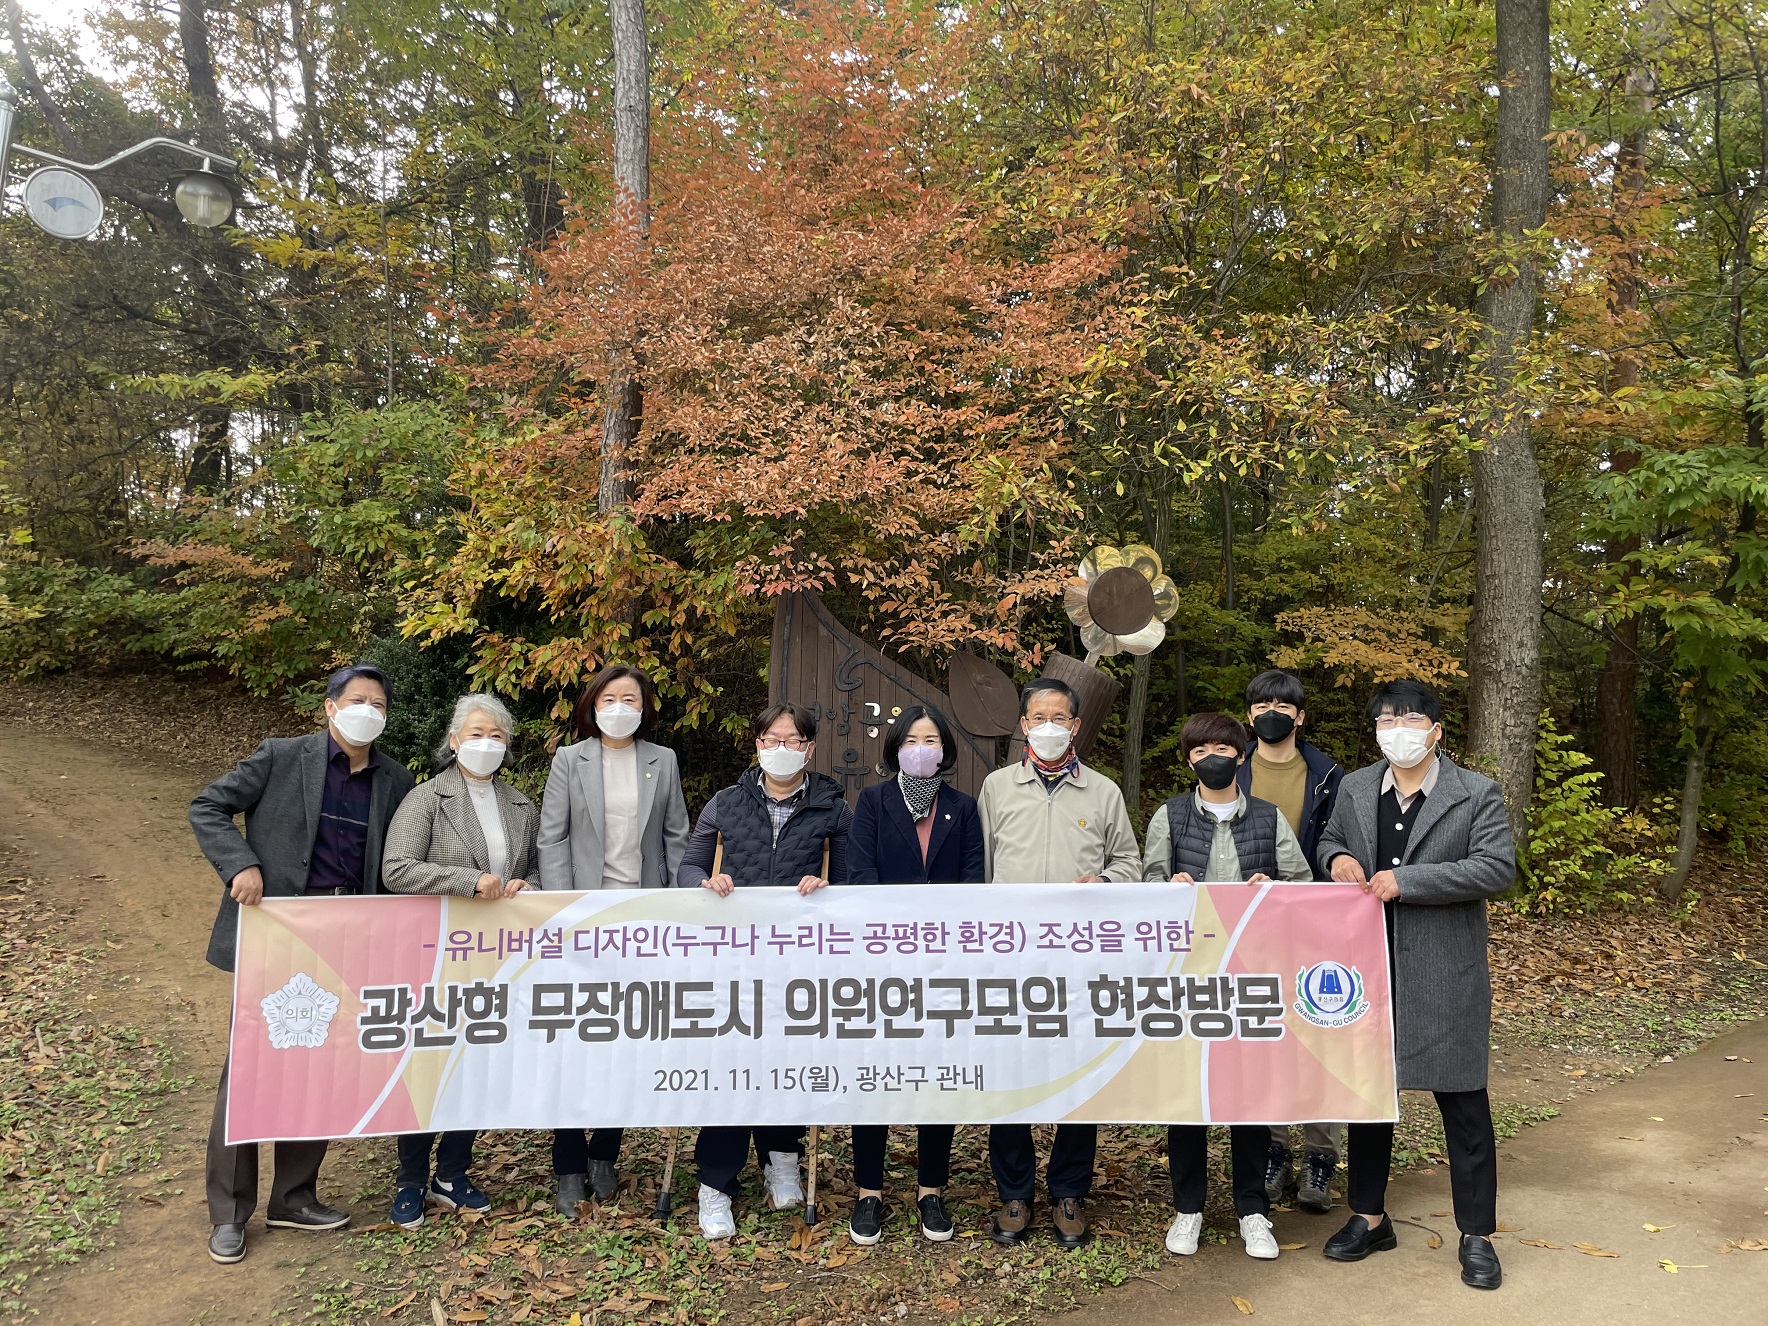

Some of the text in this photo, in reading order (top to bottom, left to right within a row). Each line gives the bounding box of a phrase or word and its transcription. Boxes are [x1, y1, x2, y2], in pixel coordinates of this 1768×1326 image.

[445, 926, 563, 961] 유니버설
[574, 923, 760, 958] 디자인(누구나
[767, 922, 854, 955] 누리는
[862, 921, 951, 954] 공평한
[958, 920, 1027, 954] 환경)
[1037, 920, 1125, 953] 조성을
[1134, 920, 1195, 953] 위한
[285, 1006, 313, 1022] 의회
[359, 972, 1285, 1052] 광산형 무장애도시 의원연구모임 현장방문
[1294, 1001, 1369, 1027] GWANGSAN-GU COUNCIL
[654, 1064, 984, 1094] 2021. 11. 15(월), 광산구 관내
